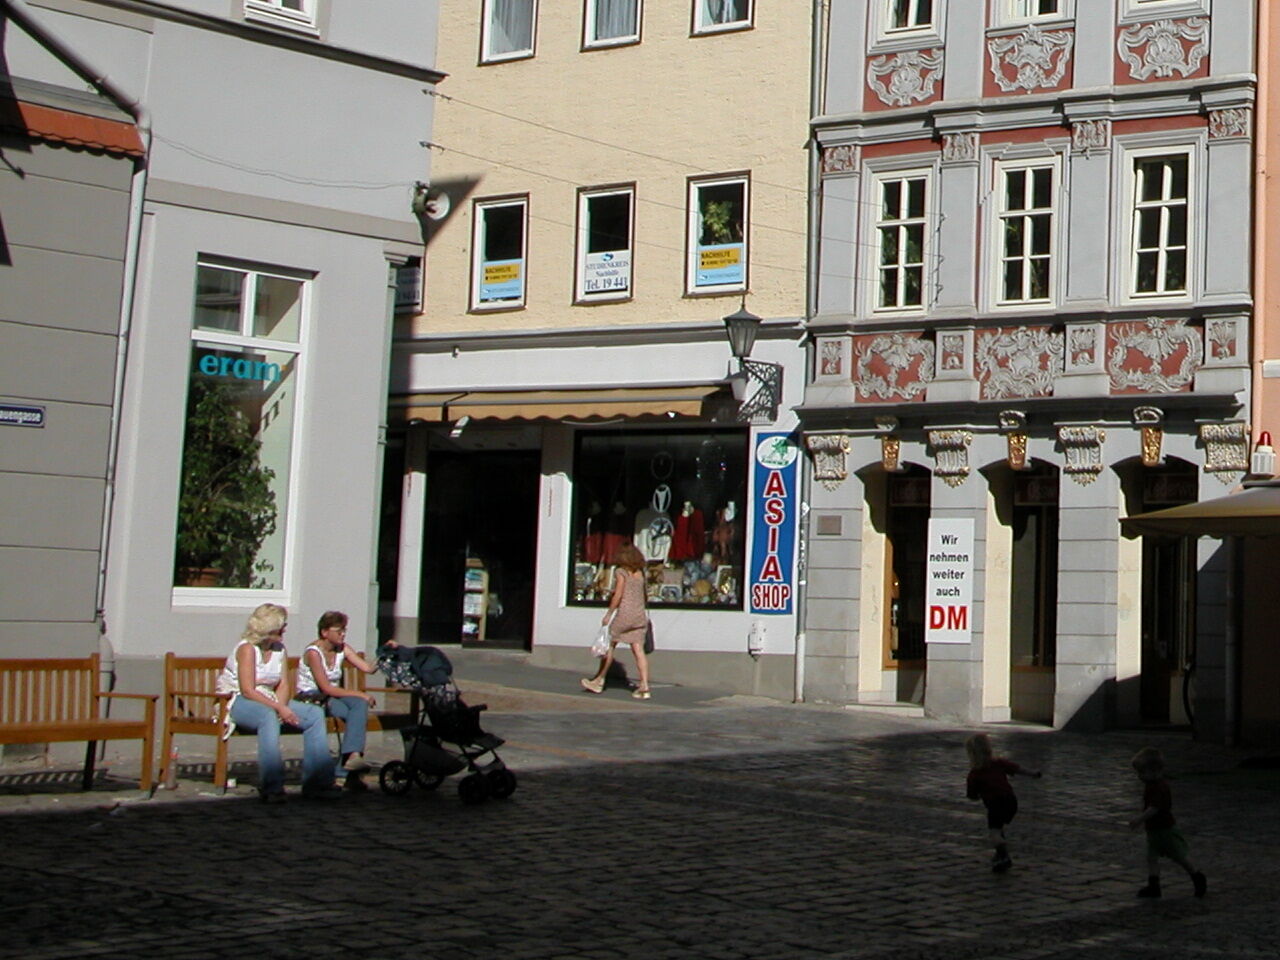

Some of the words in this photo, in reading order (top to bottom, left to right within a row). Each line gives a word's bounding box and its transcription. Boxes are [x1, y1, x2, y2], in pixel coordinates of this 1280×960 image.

[603, 278, 612, 288] 19
[199, 354, 282, 383] eram
[759, 470, 787, 582] ASIA
[941, 535, 958, 545] Wir
[929, 552, 969, 562] nehmen
[933, 569, 965, 579] weiter
[936, 586, 960, 596] auch
[752, 583, 791, 610] SHOP
[929, 605, 967, 630] DM
